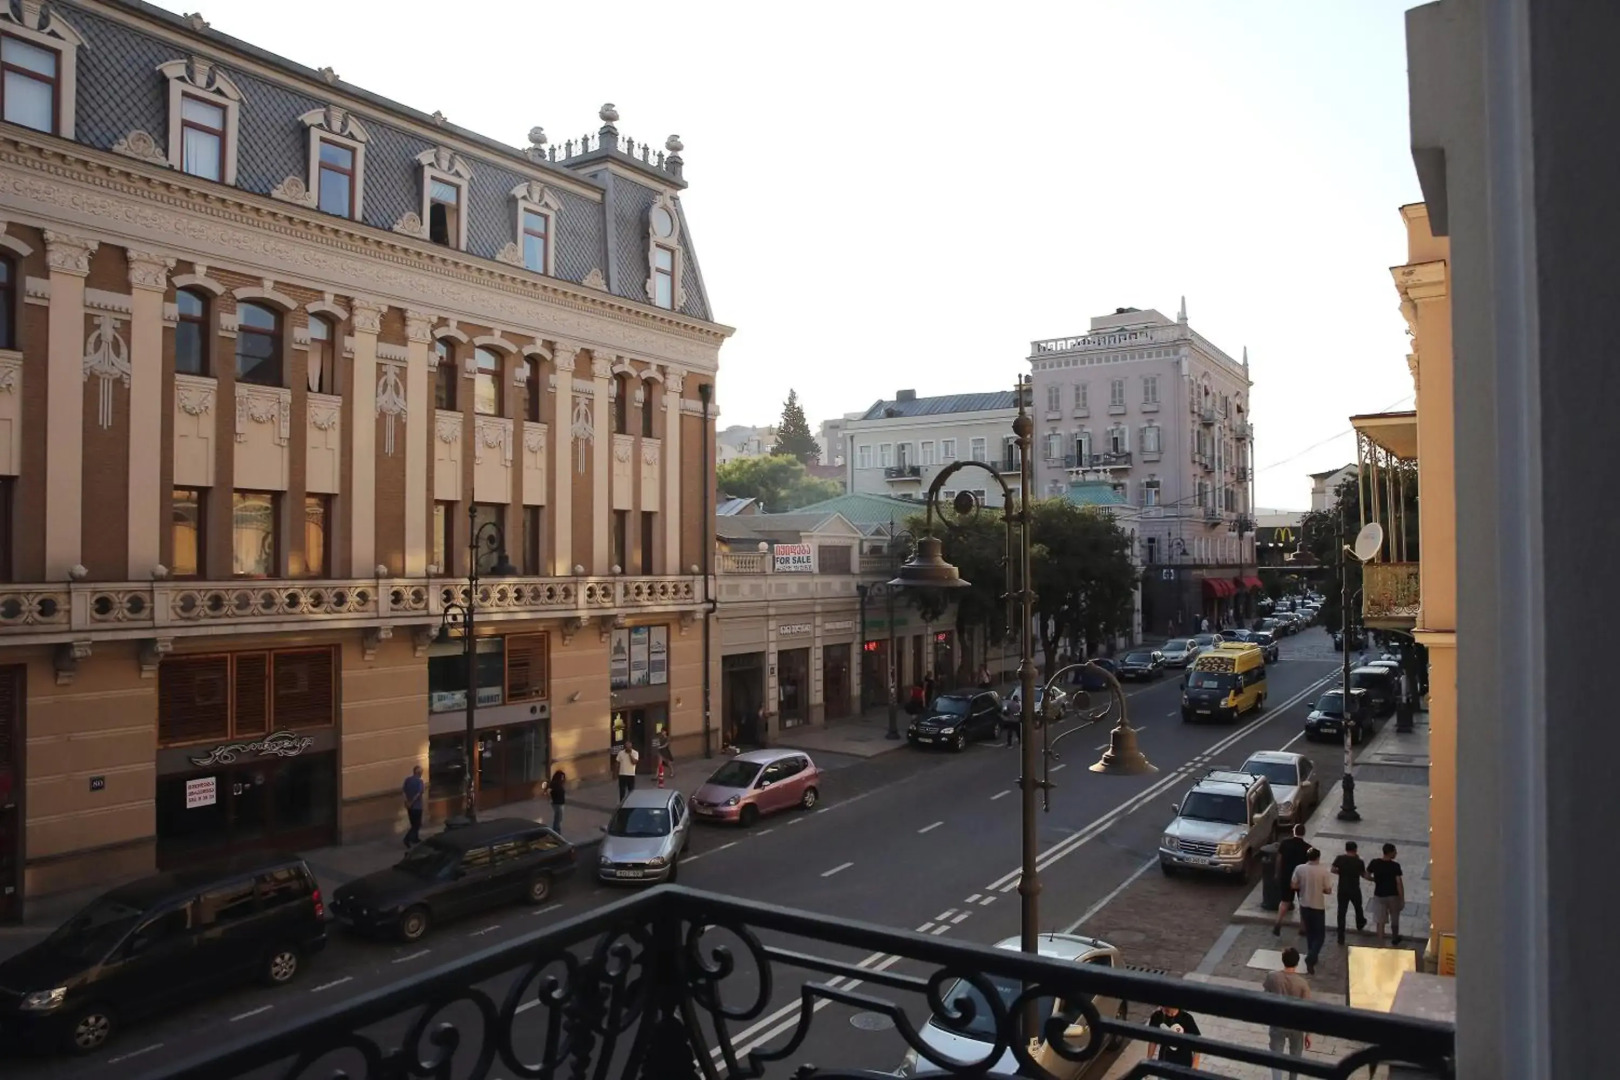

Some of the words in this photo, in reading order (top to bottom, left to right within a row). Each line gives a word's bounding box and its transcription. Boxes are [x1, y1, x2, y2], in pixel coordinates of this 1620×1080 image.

[775, 544, 811, 555] იყიდება
[776, 556, 791, 565] FOR
[792, 555, 812, 564] SALE
